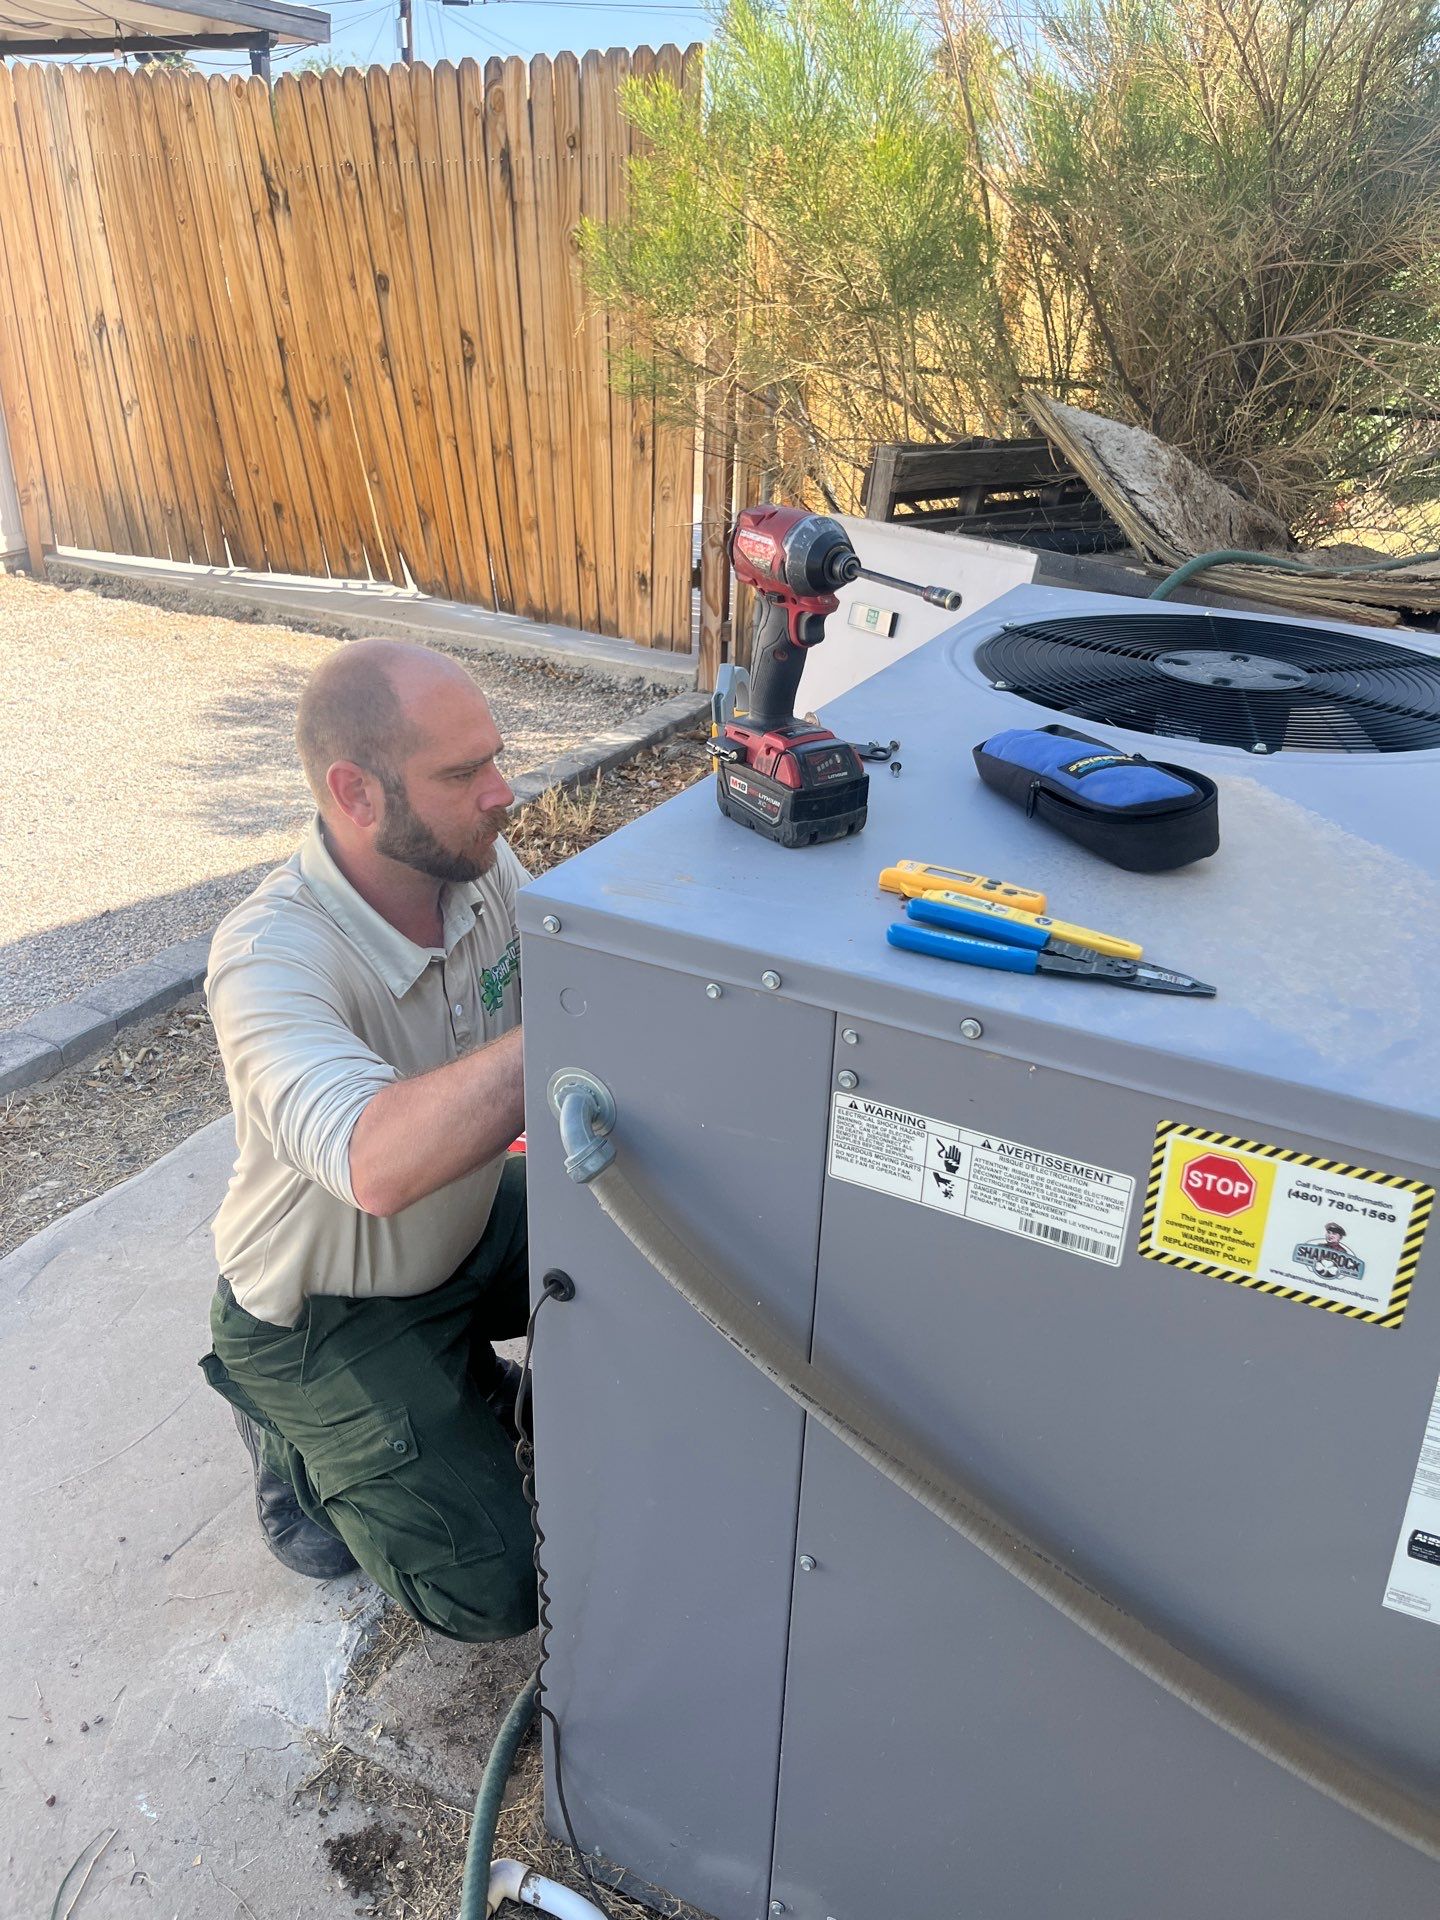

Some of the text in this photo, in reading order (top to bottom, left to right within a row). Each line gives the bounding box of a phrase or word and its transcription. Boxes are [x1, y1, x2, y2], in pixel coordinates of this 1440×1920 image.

[731, 779, 746, 791] M18
[838, 1108, 925, 1139] ELECTRICAL SHOCK HAZARD
[863, 1103, 926, 1129] WARNING
[836, 1129, 906, 1154] REMOTE ELECTRIC POWER
[836, 1134, 860, 1145] SUPPLIES
[862, 1142, 883, 1152] BEFORE
[866, 1123, 879, 1131] RISK
[889, 1130, 915, 1141] ELECTRIC
[867, 1133, 901, 1147] DISCONNECT
[872, 1130, 890, 1139] CAUSE
[891, 1136, 910, 1145] INJURY
[835, 1141, 921, 1172] HAZARDOUS MOVING PARTS
[836, 1154, 854, 1163] WHILE
[856, 1160, 867, 1168] FAN
[876, 1166, 913, 1181] OPERATING.
[846, 1152, 858, 1160] NOT
[860, 1156, 880, 1167] REACH
[882, 1163, 896, 1171] INTO
[898, 1168, 910, 1176] FAN
[997, 1143, 1113, 1185] AVERTISSEMENT
[999, 1156, 1023, 1168] RISQUE
[974, 1163, 1002, 1176] POUVANT
[1004, 1172, 1029, 1184] CAUSER
[1031, 1180, 1044, 1188] DES
[1045, 1184, 1083, 1200] BLESSURES
[1012, 1168, 1035, 1180] RISQUE
[1036, 1175, 1045, 1183] DE
[1187, 1169, 1250, 1201] STOP
[970, 1195, 997, 1207] PENDANT
[974, 1184, 997, 1196] DANGER
[1030, 1201, 1066, 1217] MOUVEMENT
[993, 1197, 1016, 1208] METTRE
[1015, 1187, 1035, 1197] AVANT
[1021, 1182, 1045, 1194] TOUTES
[1046, 1190, 1058, 1198] LES
[1059, 1194, 1109, 1213] ALIMENTATIONS
[1295, 1180, 1394, 1210] Call for more information
[1288, 1189, 1397, 1224] (480) 780-1569
[1166, 1219, 1195, 1232] covered
[1197, 1227, 1206, 1236] by
[1220, 1234, 1256, 1248] extended
[1180, 1213, 1243, 1236] This unit may be
[1163, 1236, 1252, 1266] REPLACEMENT POLICY
[1181, 1232, 1225, 1249] WARRANTY
[1297, 1244, 1362, 1272] SHAMROCK
